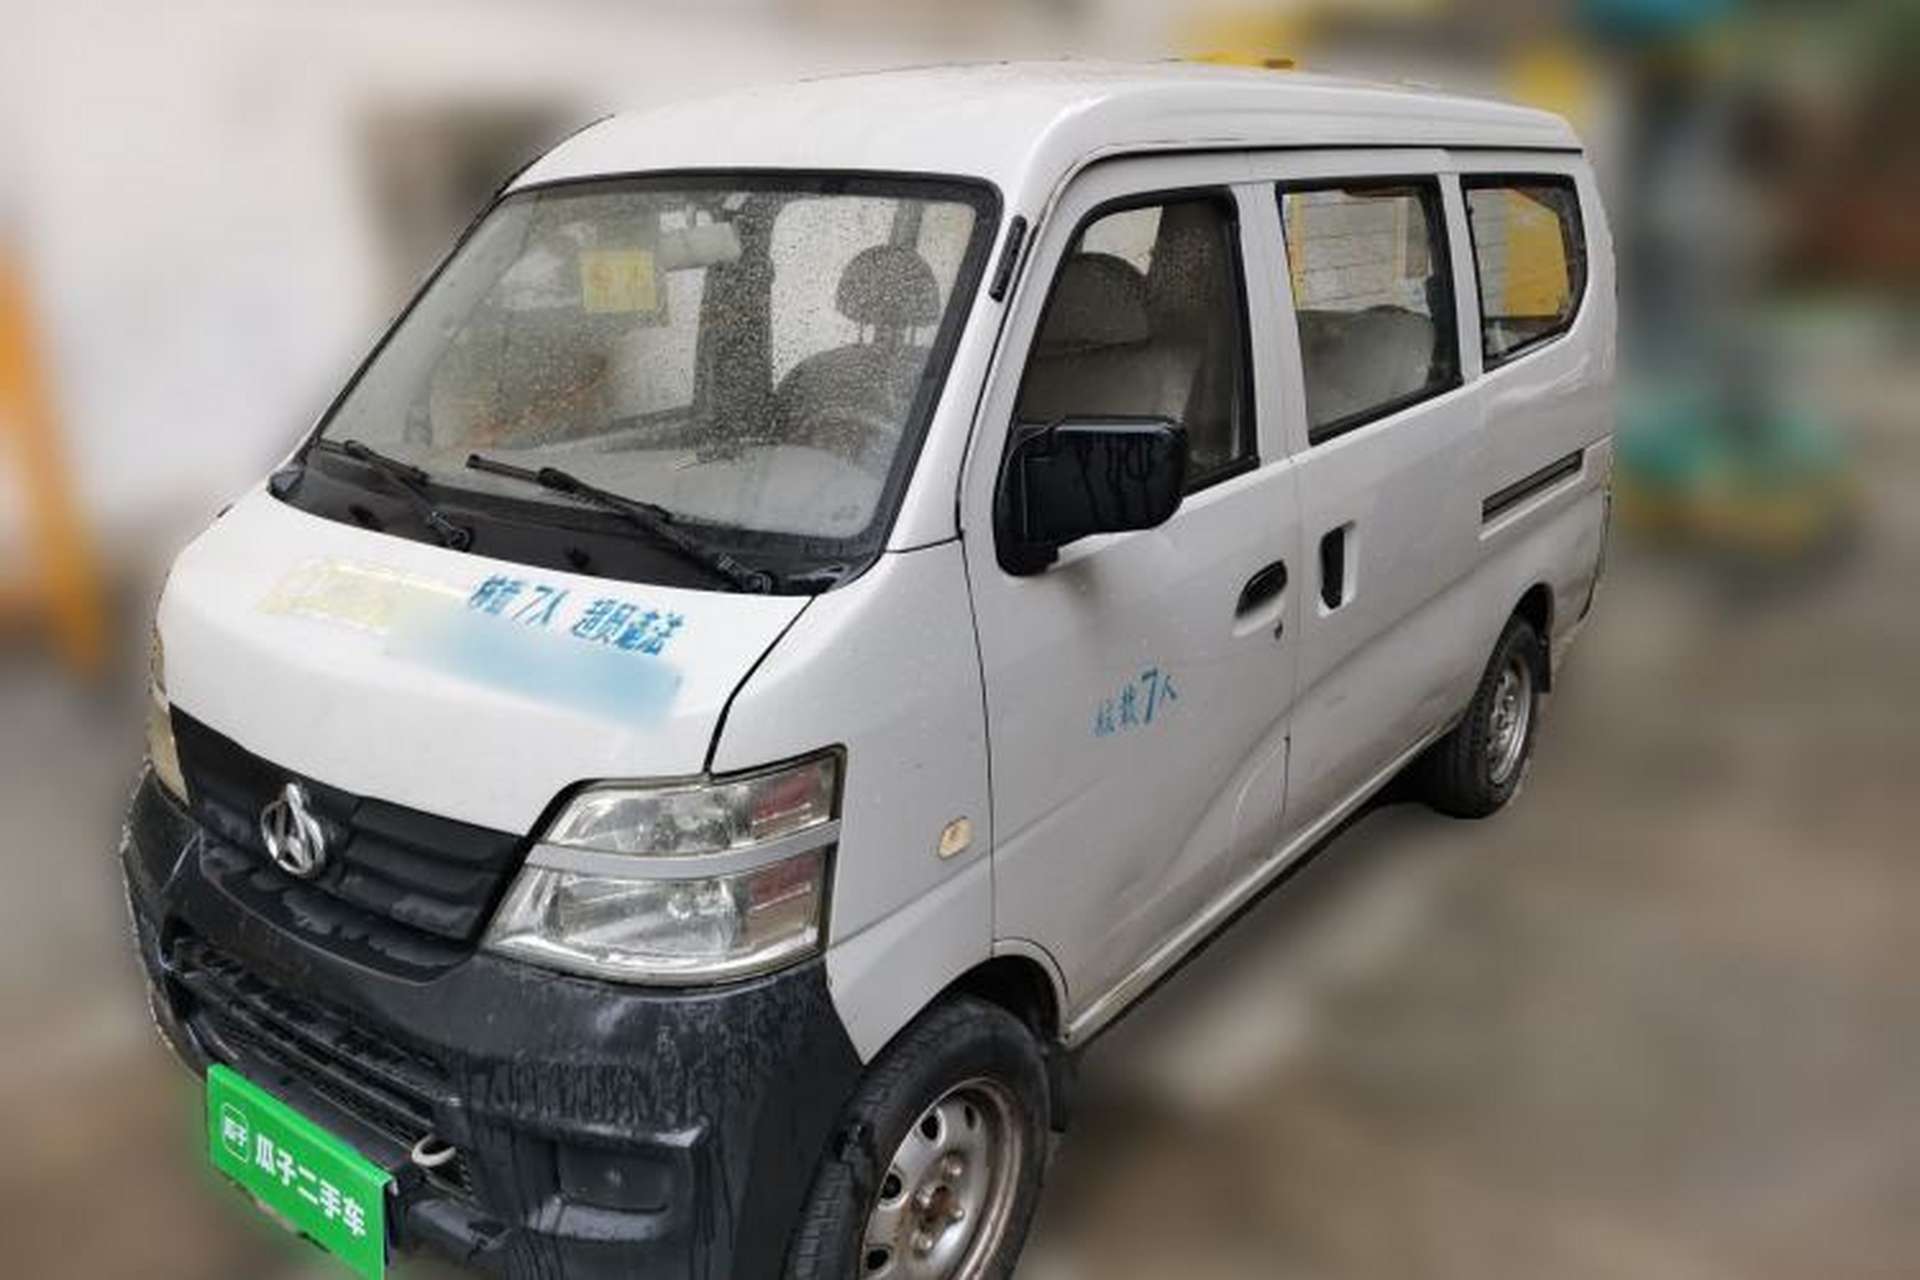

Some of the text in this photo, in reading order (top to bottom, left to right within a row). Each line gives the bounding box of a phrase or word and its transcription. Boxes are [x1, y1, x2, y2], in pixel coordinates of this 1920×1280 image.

[255, 1133, 366, 1237] 瓜子二手车
